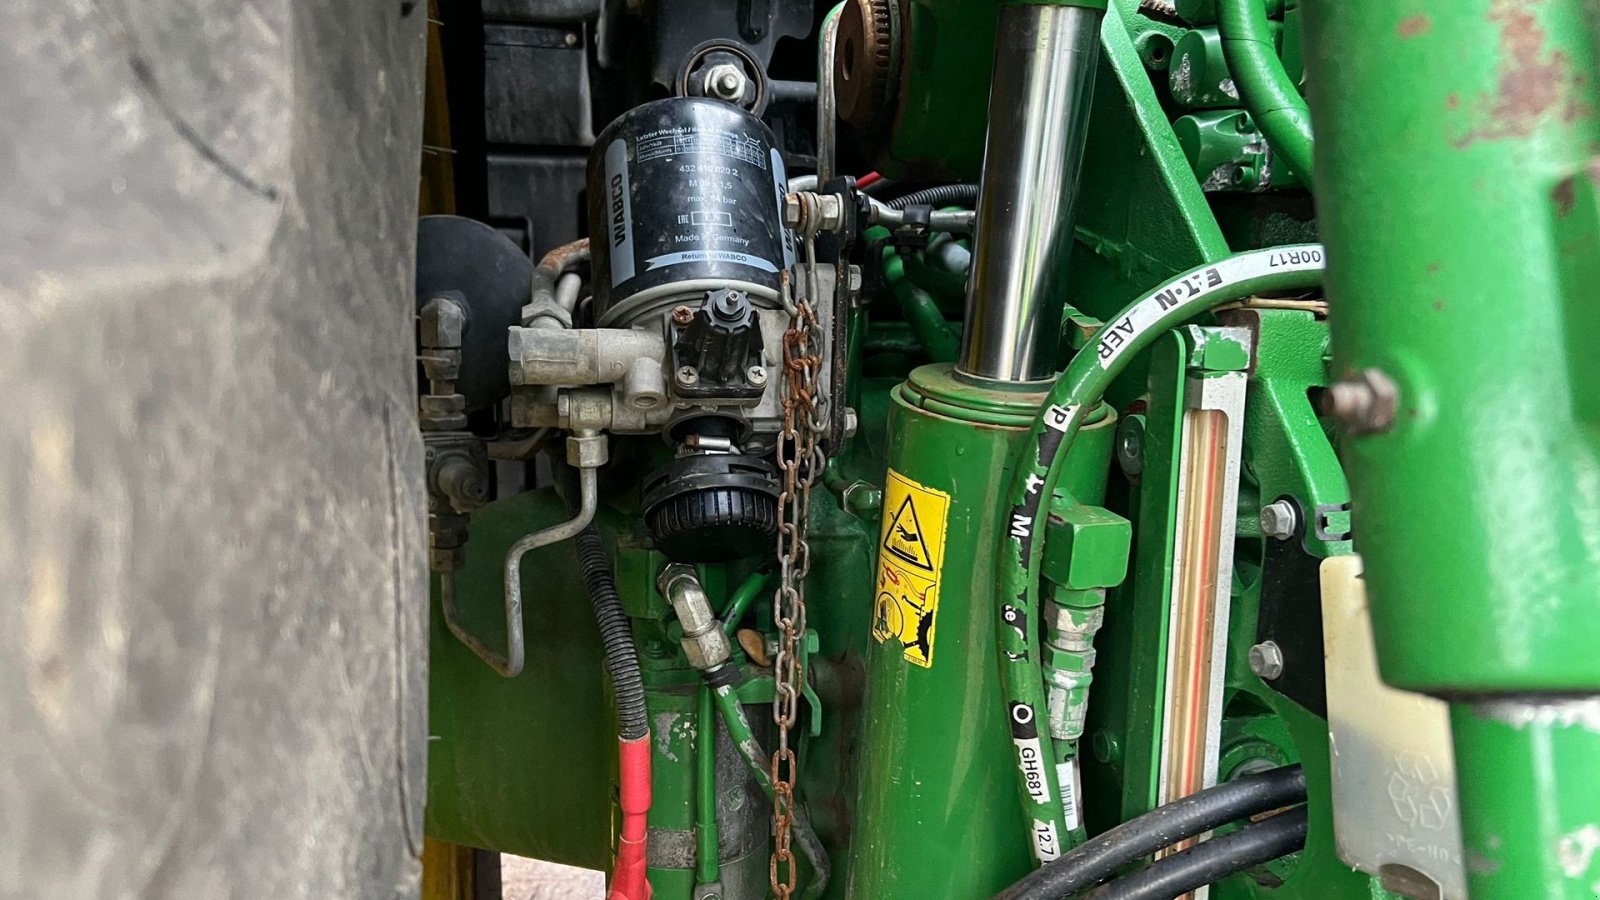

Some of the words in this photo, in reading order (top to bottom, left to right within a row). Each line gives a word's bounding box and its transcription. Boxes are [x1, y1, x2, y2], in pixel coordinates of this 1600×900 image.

[722, 195, 737, 205] bar
[611, 173, 626, 249] WABCO
[675, 233, 700, 243] Made
[712, 233, 750, 247] Germany
[681, 253, 706, 261] Return
[718, 253, 747, 262] WABCO
[1037, 826, 1055, 856] 12.7
